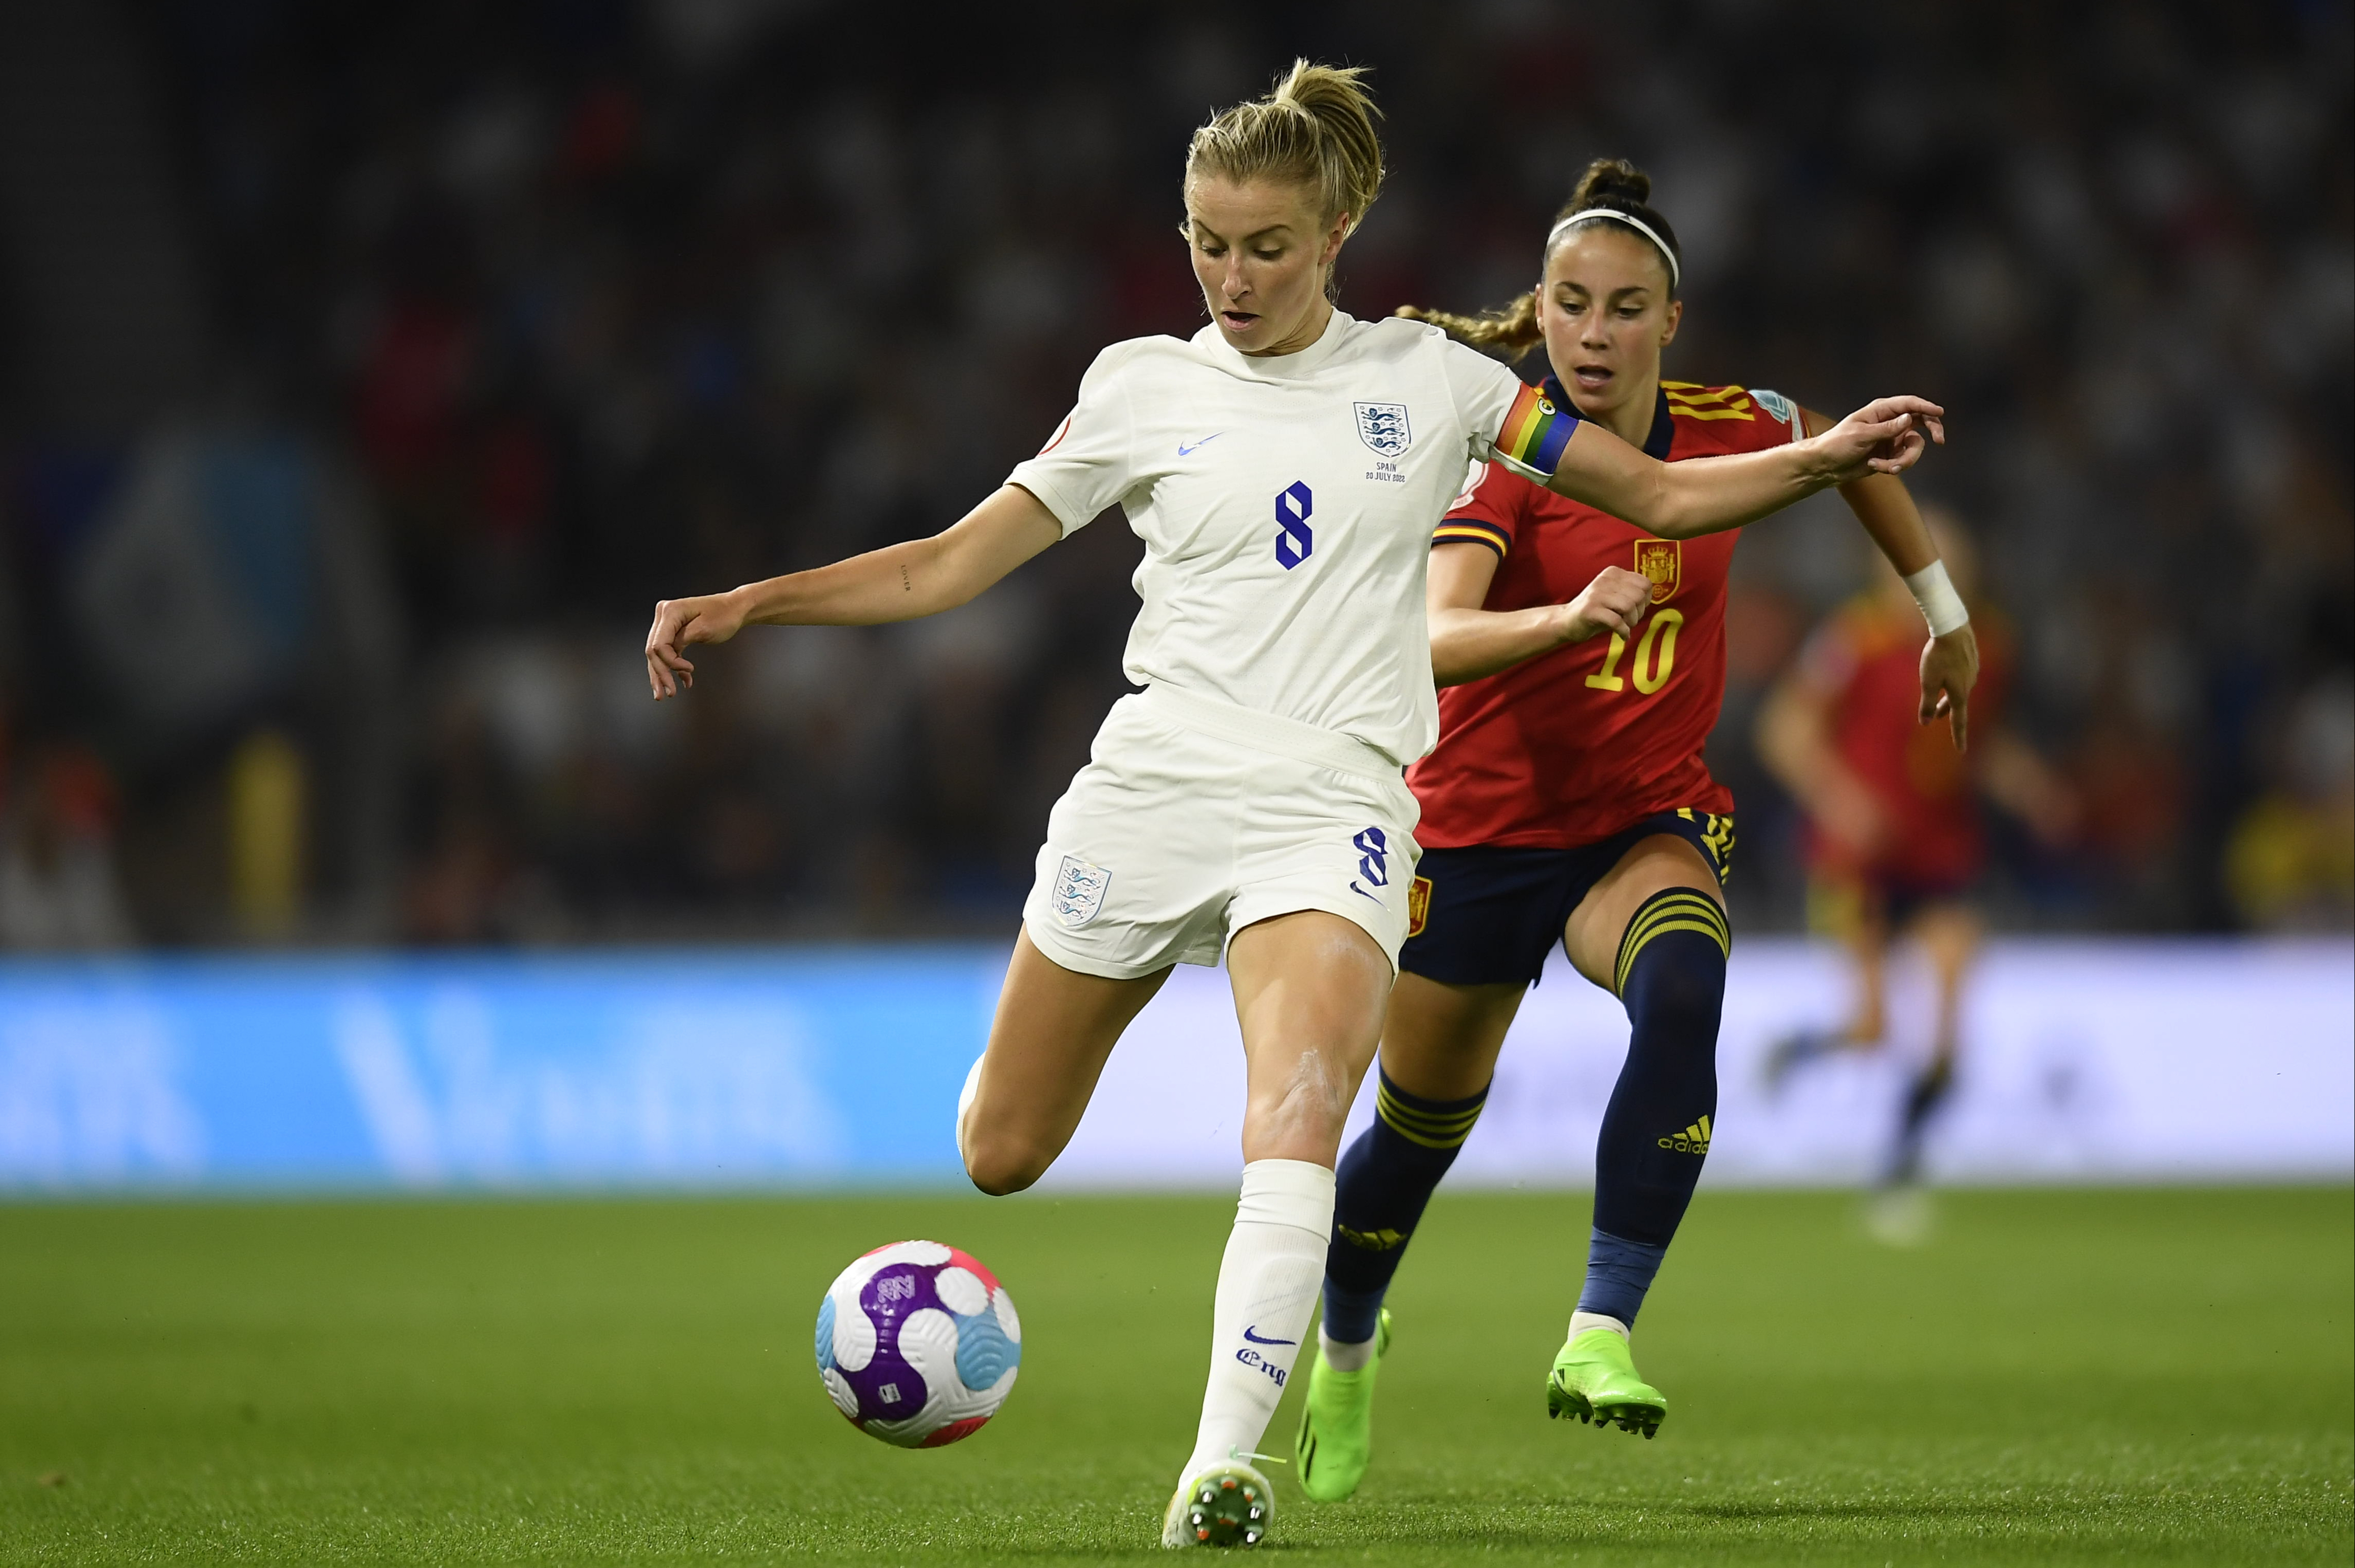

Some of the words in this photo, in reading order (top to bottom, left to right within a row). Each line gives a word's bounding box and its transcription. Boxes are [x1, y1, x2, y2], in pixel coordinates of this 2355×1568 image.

[1375, 472, 1392, 482] JULY
[1393, 474, 1406, 483] 2022
[1376, 462, 1397, 472] SPAIN
[1275, 480, 1313, 571] 8
[901, 565, 911, 592] LOVER
[1585, 608, 1683, 694] 10
[1353, 827, 1388, 886] 8
[1657, 1138, 1709, 1154] adida
[1236, 1349, 1286, 1386] Eng
